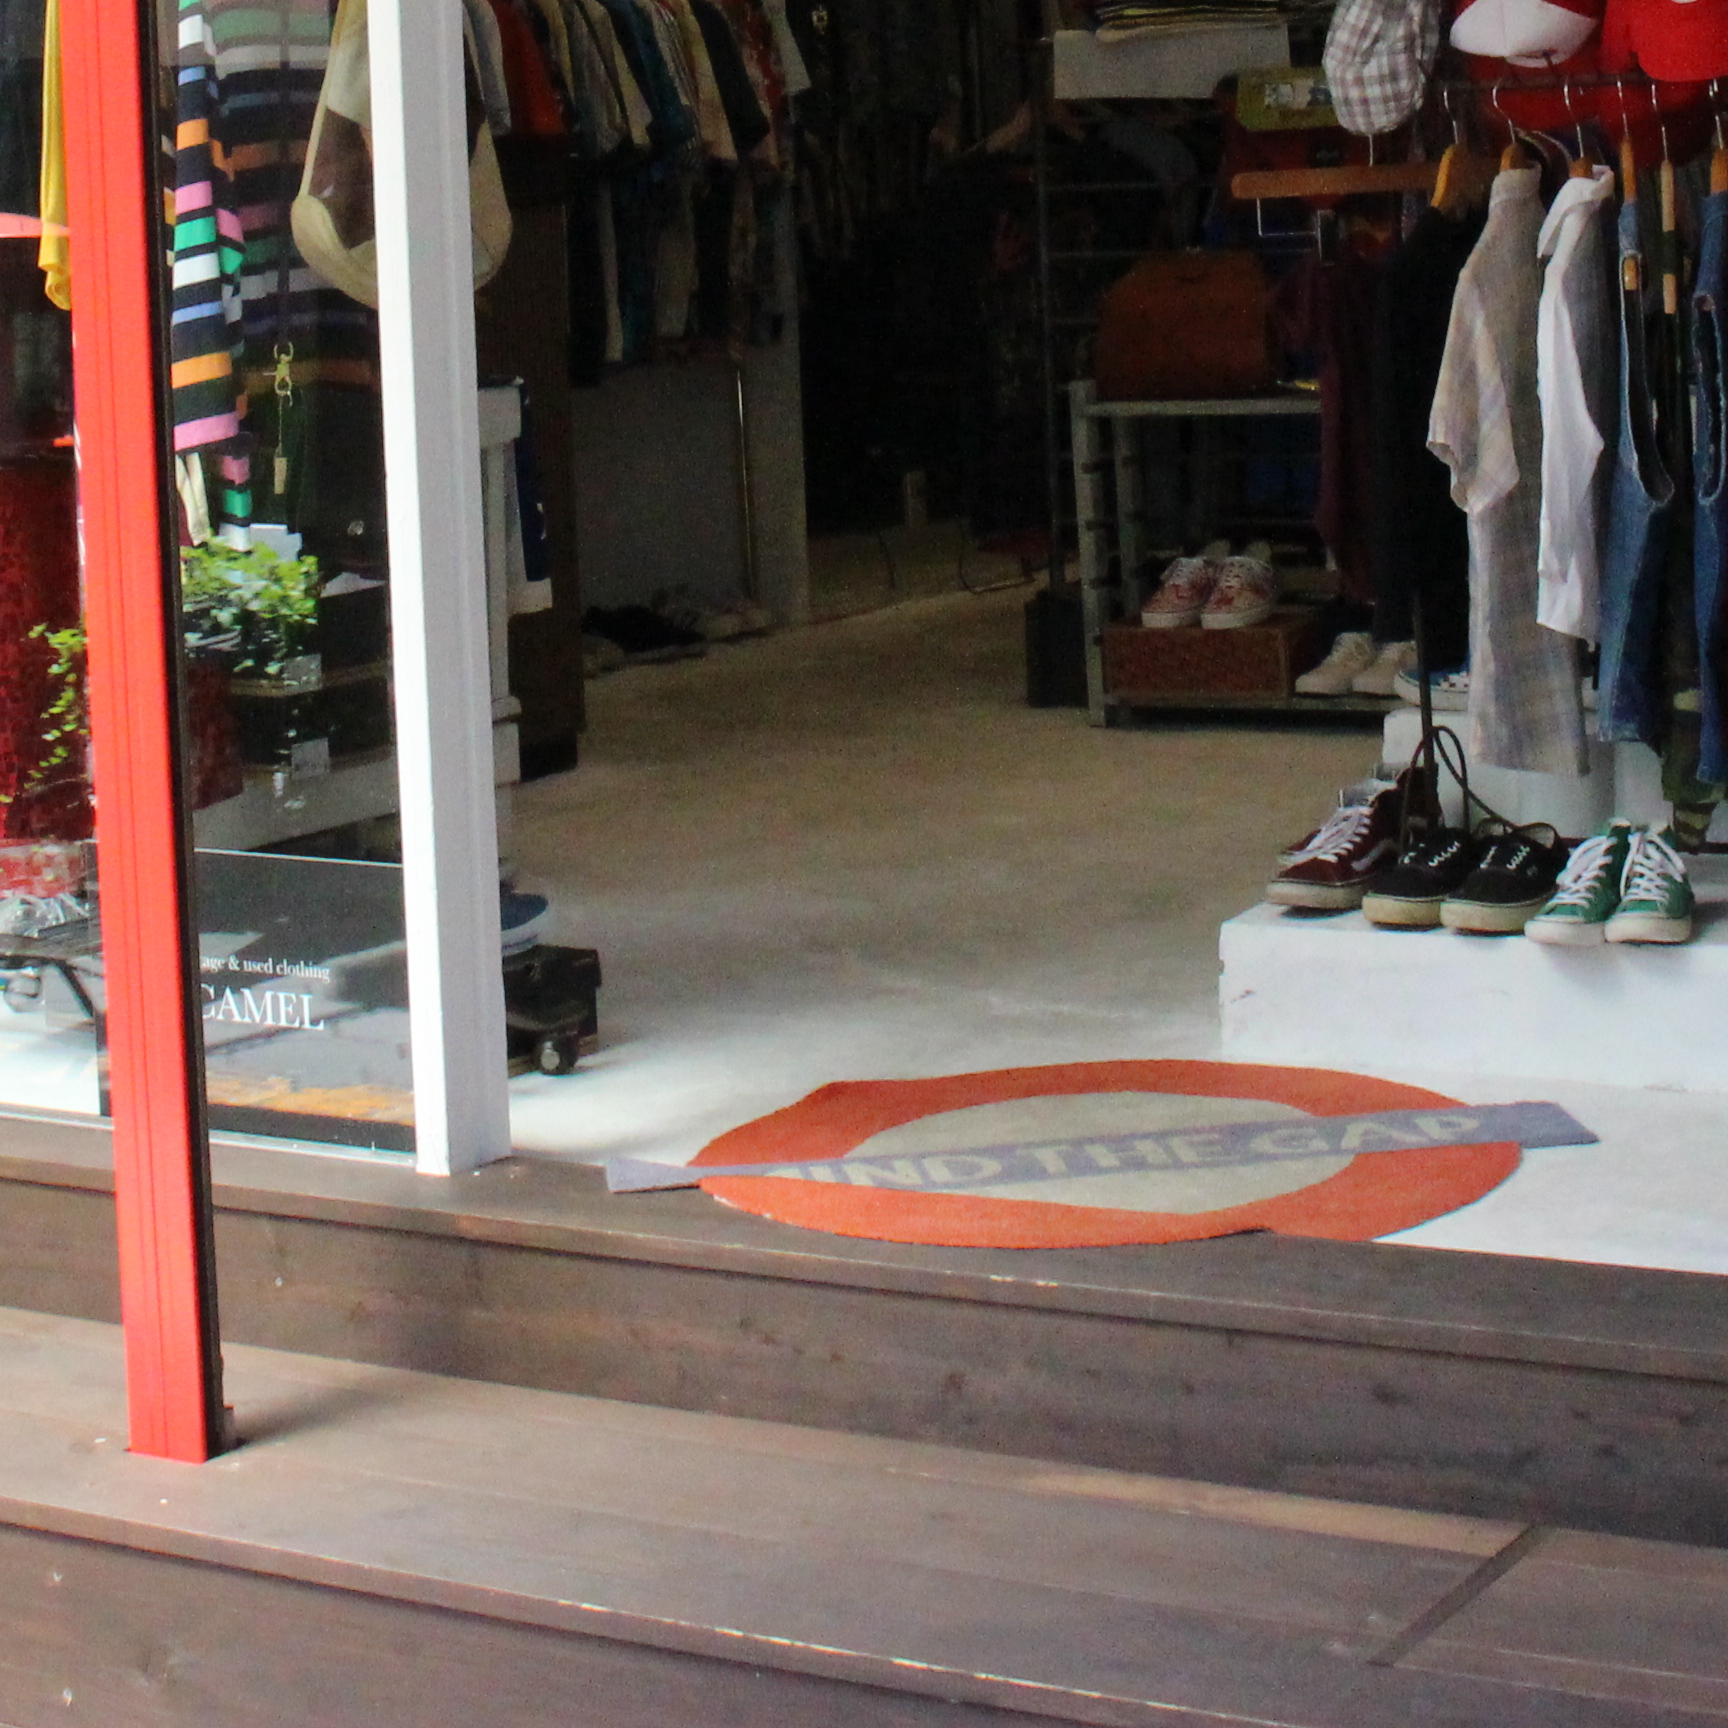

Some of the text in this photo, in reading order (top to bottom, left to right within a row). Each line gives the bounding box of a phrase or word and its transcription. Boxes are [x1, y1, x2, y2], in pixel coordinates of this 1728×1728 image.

[228, 954, 241, 971] &
[243, 957, 274, 974] used
[275, 958, 330, 983] clothing
[201, 983, 324, 1030] CAMEL
[1026, 1134, 1224, 1177] THE
[1248, 1114, 1482, 1156] GAP
